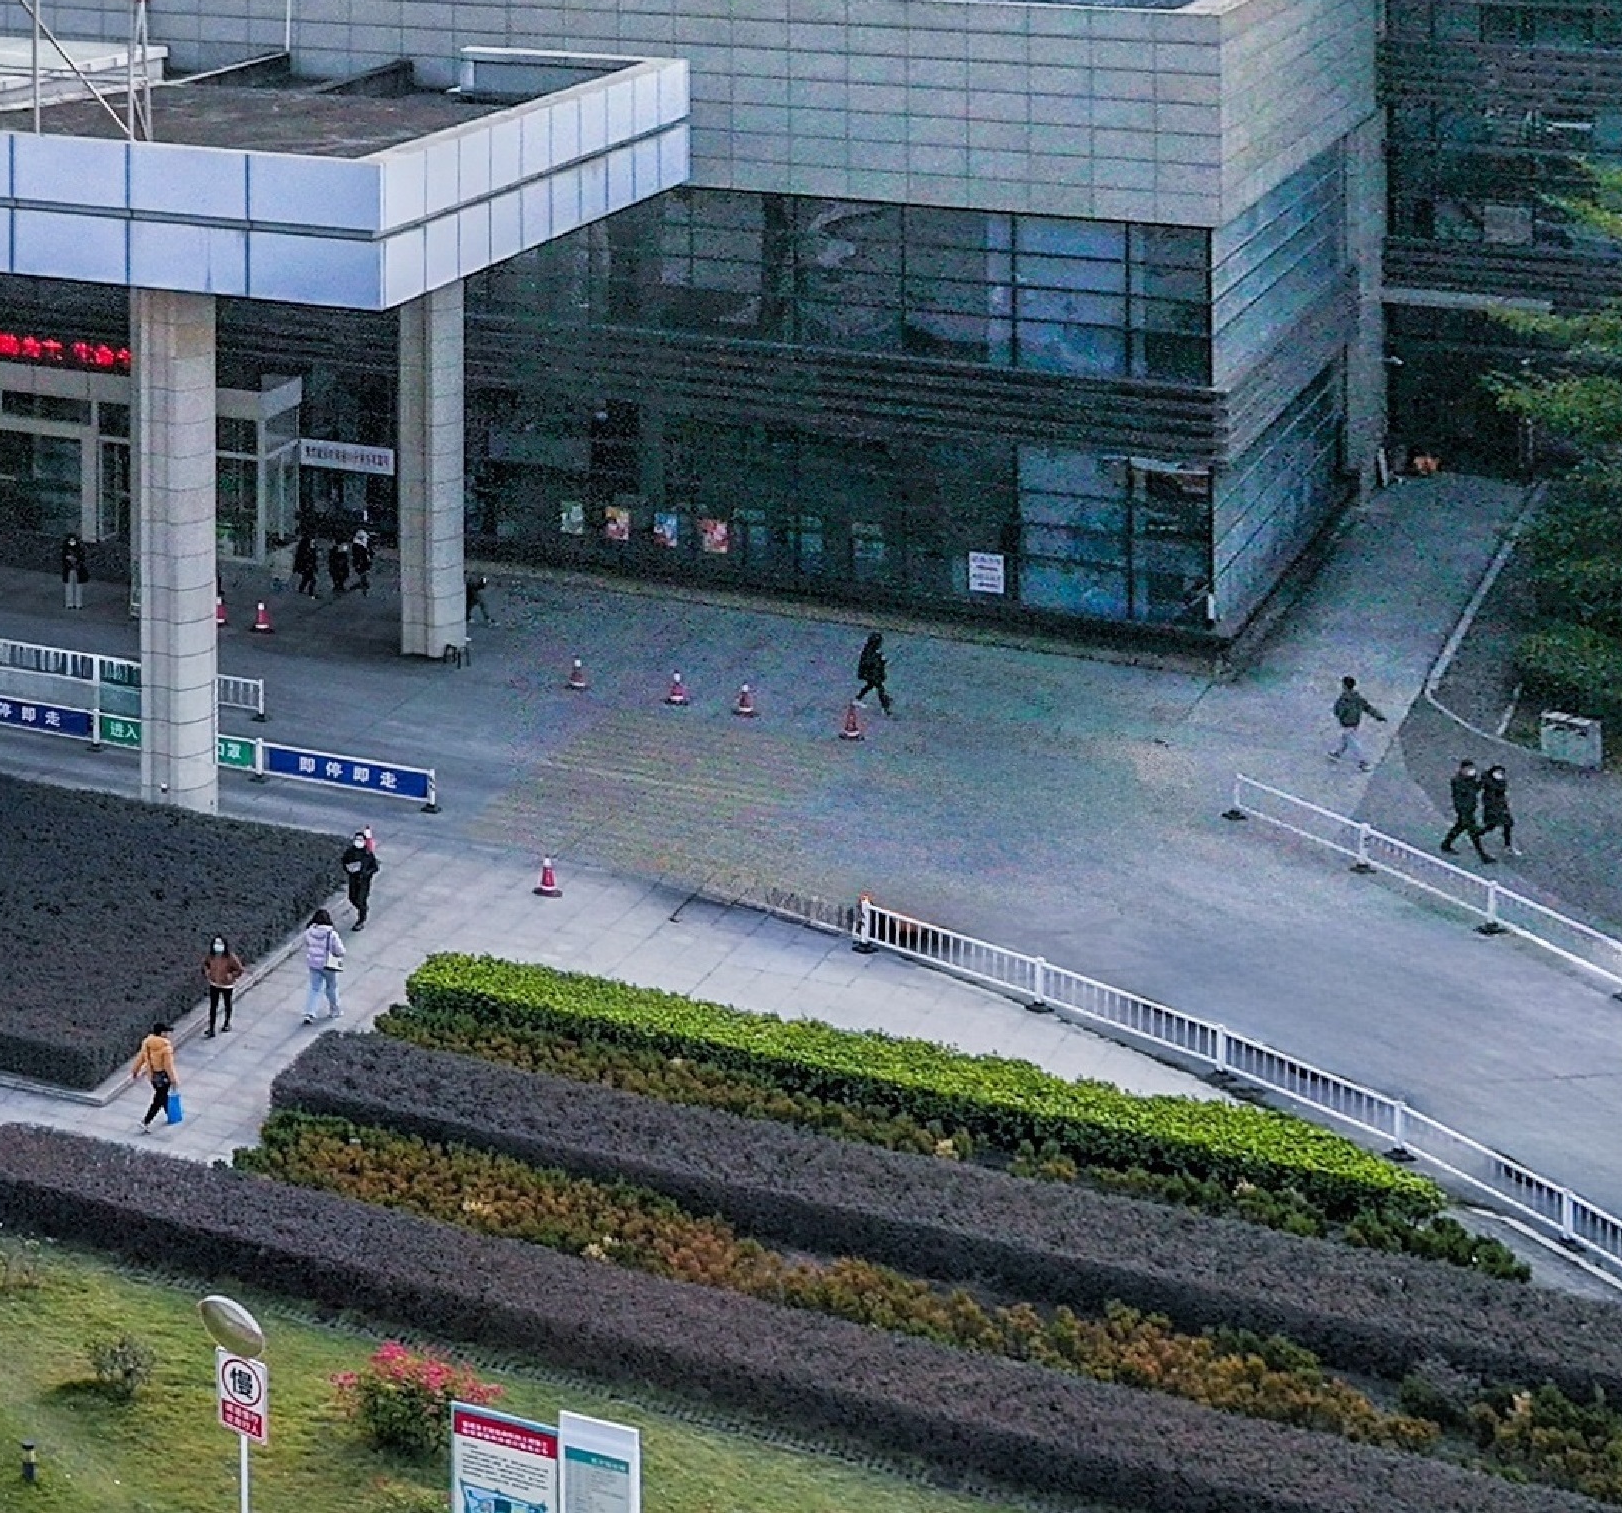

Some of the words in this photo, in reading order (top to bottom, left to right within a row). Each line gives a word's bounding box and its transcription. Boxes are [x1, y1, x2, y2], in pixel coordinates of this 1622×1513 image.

[299, 756, 398, 789] 即停即走
[229, 1367, 254, 1401] 慢
